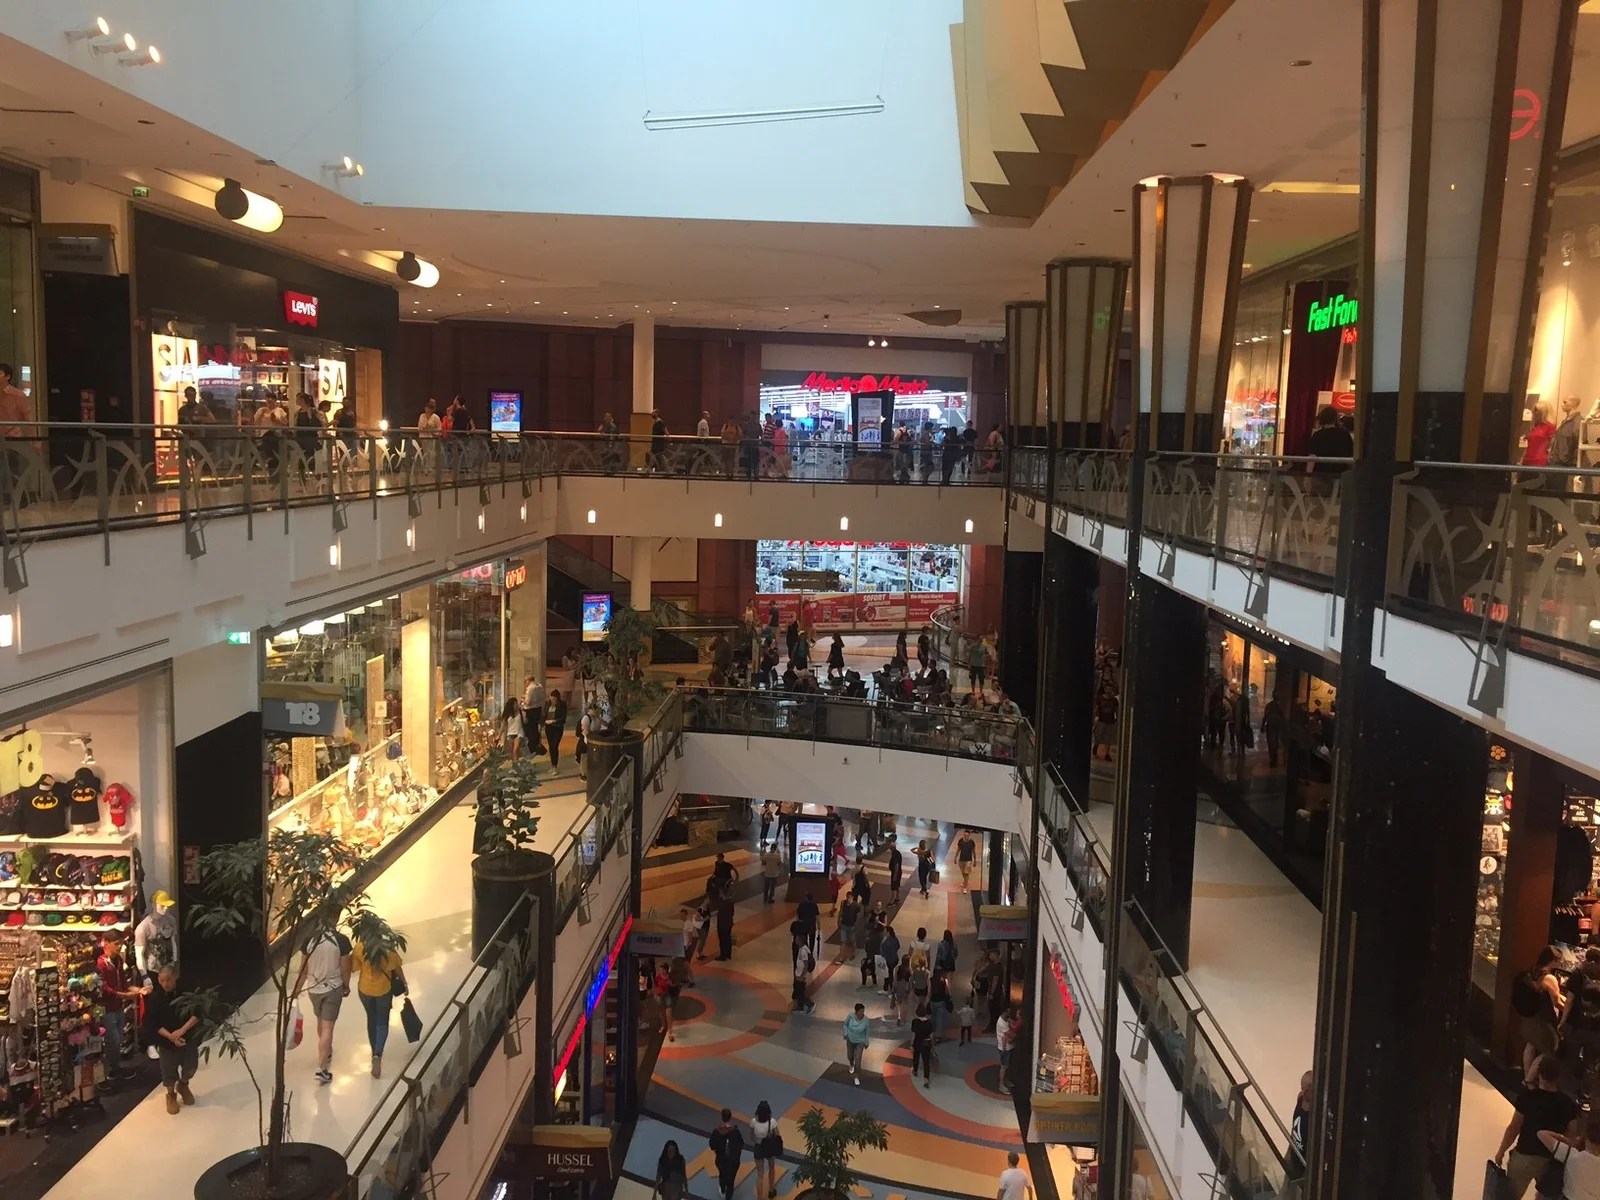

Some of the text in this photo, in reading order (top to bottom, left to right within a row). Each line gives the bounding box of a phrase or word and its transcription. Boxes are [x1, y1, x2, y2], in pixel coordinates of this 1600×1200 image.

[1308, 298, 1333, 331] Fast
[801, 372, 926, 394] Media Markt
[863, 594, 886, 602] SOFORT
[547, 1153, 593, 1166] HUSSEL
